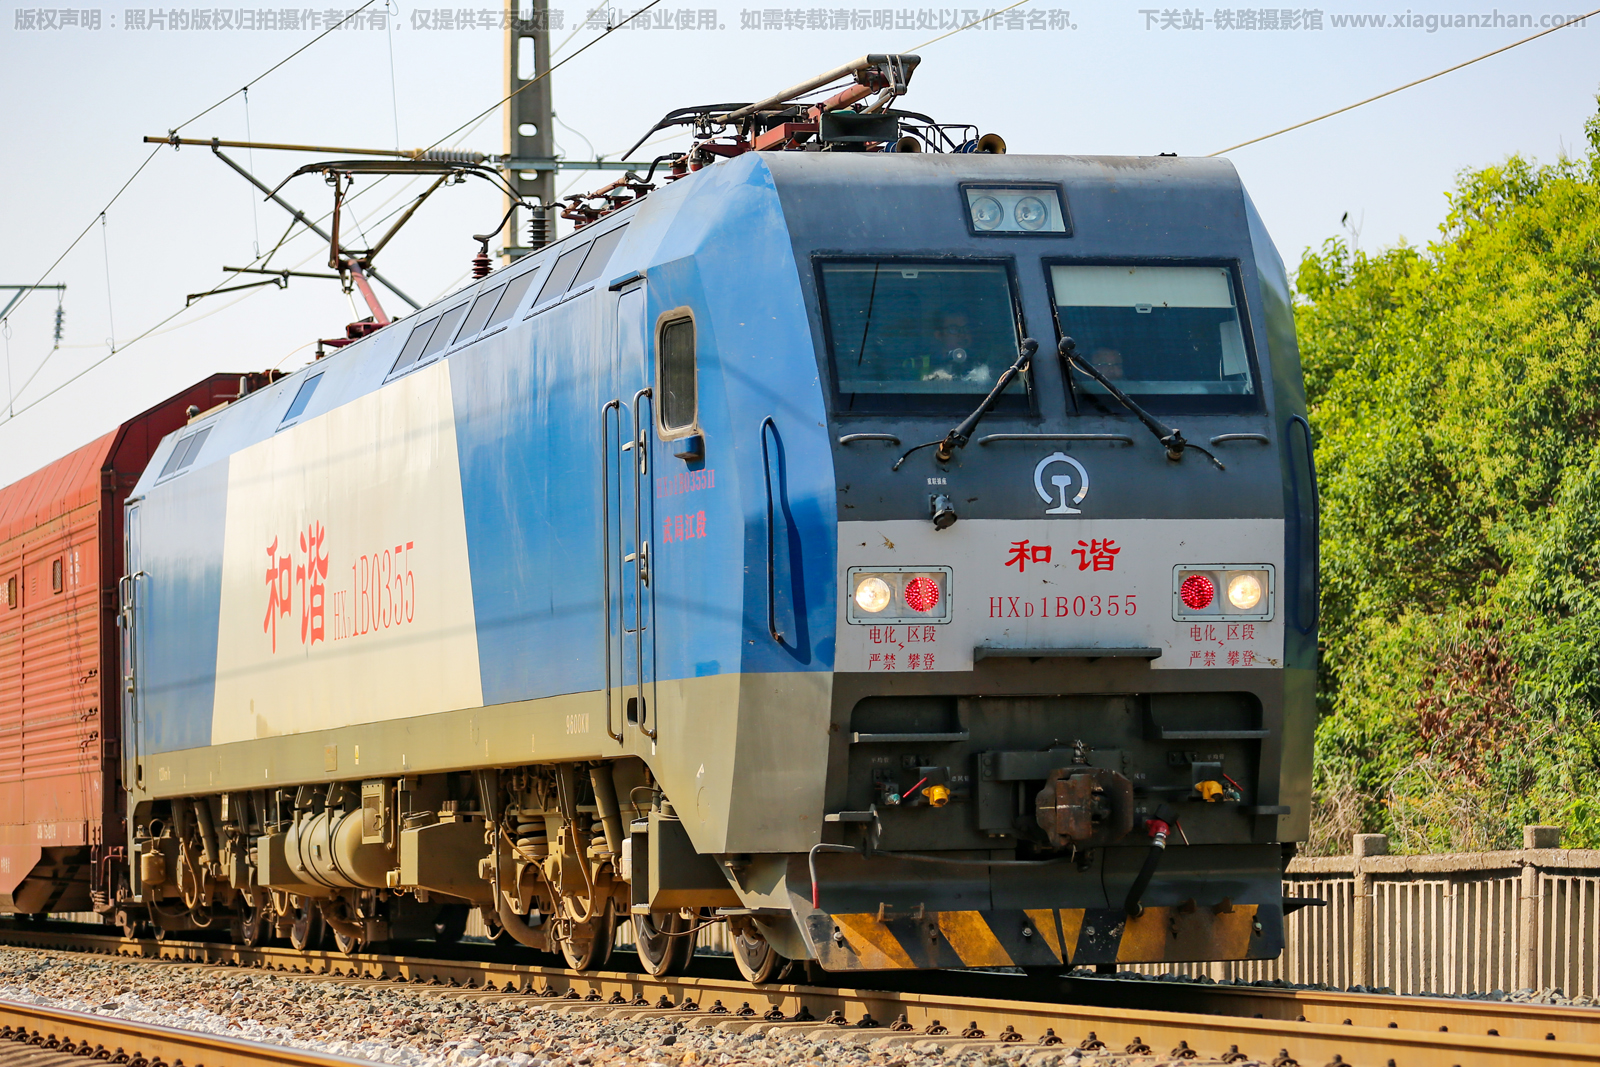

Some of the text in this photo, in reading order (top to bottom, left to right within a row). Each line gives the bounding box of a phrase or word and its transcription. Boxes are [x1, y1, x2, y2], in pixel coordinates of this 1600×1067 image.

[1004, 537, 1122, 573] 和谐
[263, 519, 329, 655] 和谐
[989, 594, 1138, 618] HXD1B0355
